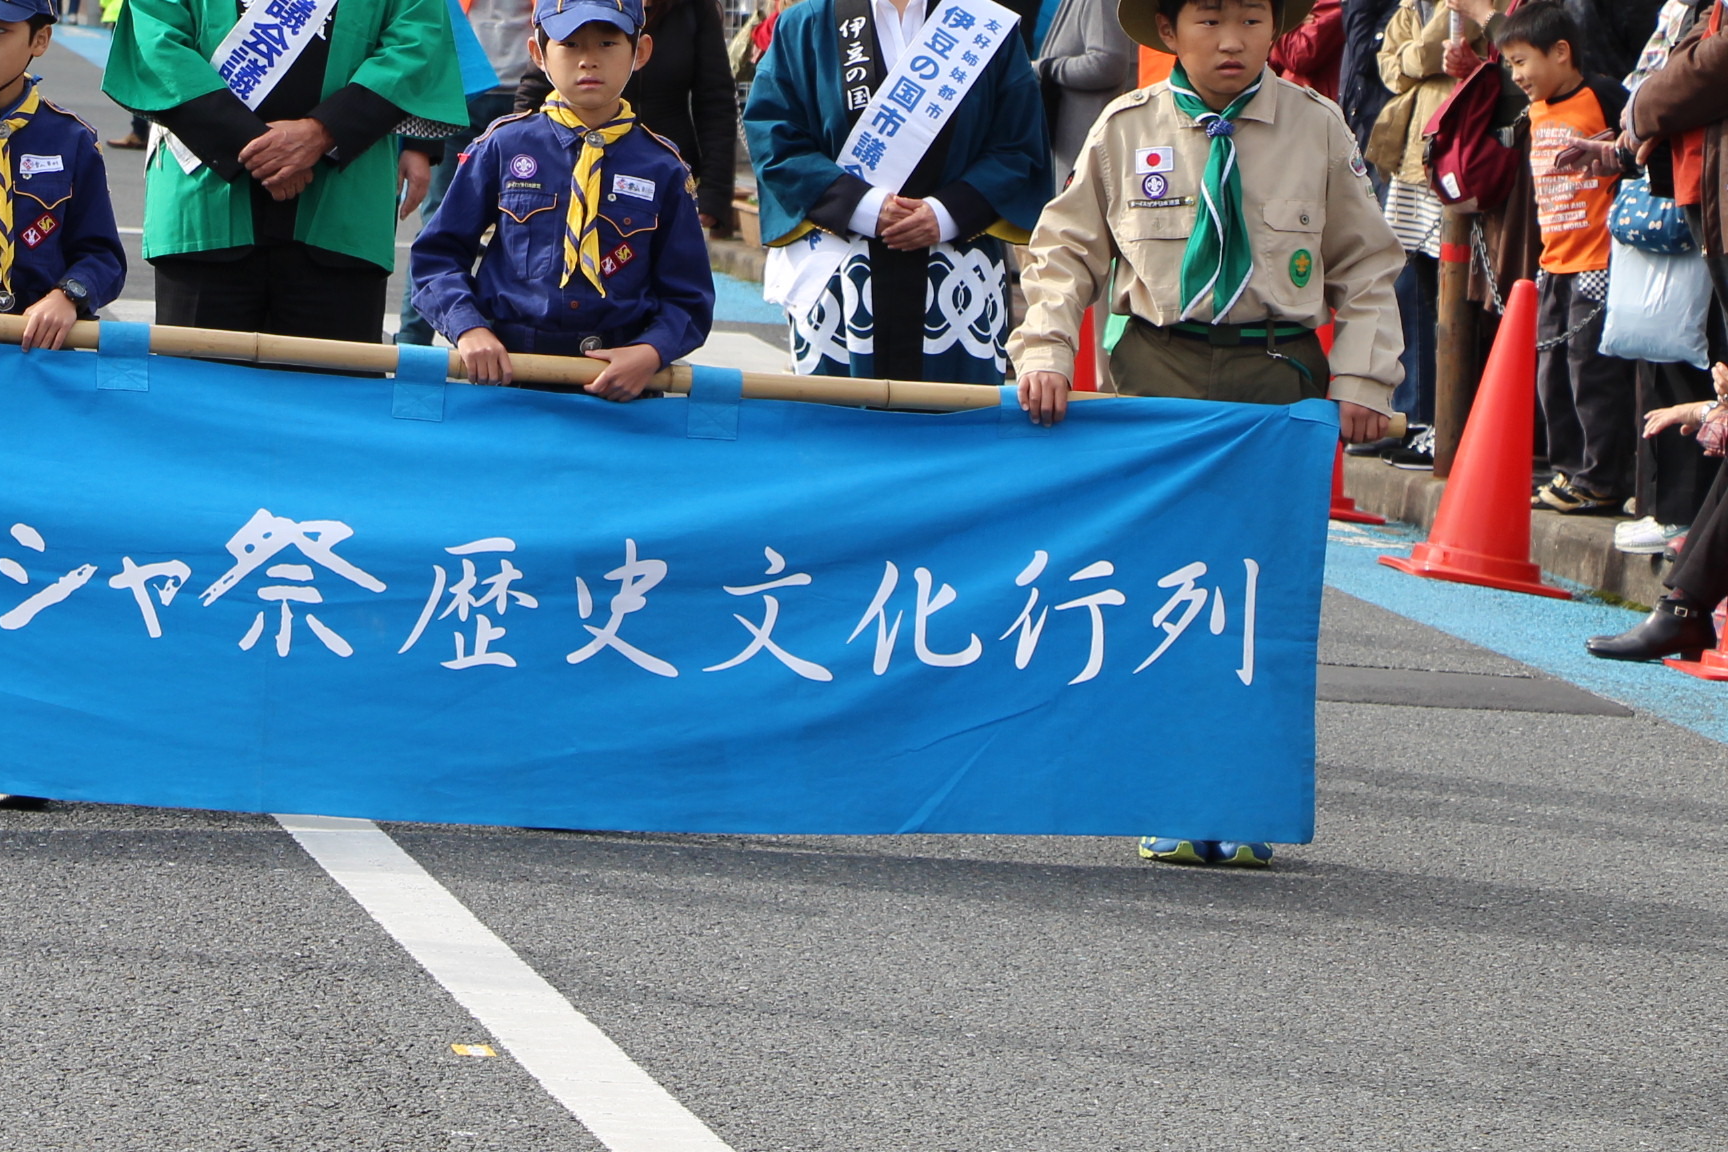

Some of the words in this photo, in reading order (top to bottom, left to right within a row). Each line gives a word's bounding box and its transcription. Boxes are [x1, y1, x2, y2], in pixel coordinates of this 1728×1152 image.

[839, 16, 873, 112] 伊豆の国
[924, 17, 1003, 121] 友好姉妹都市
